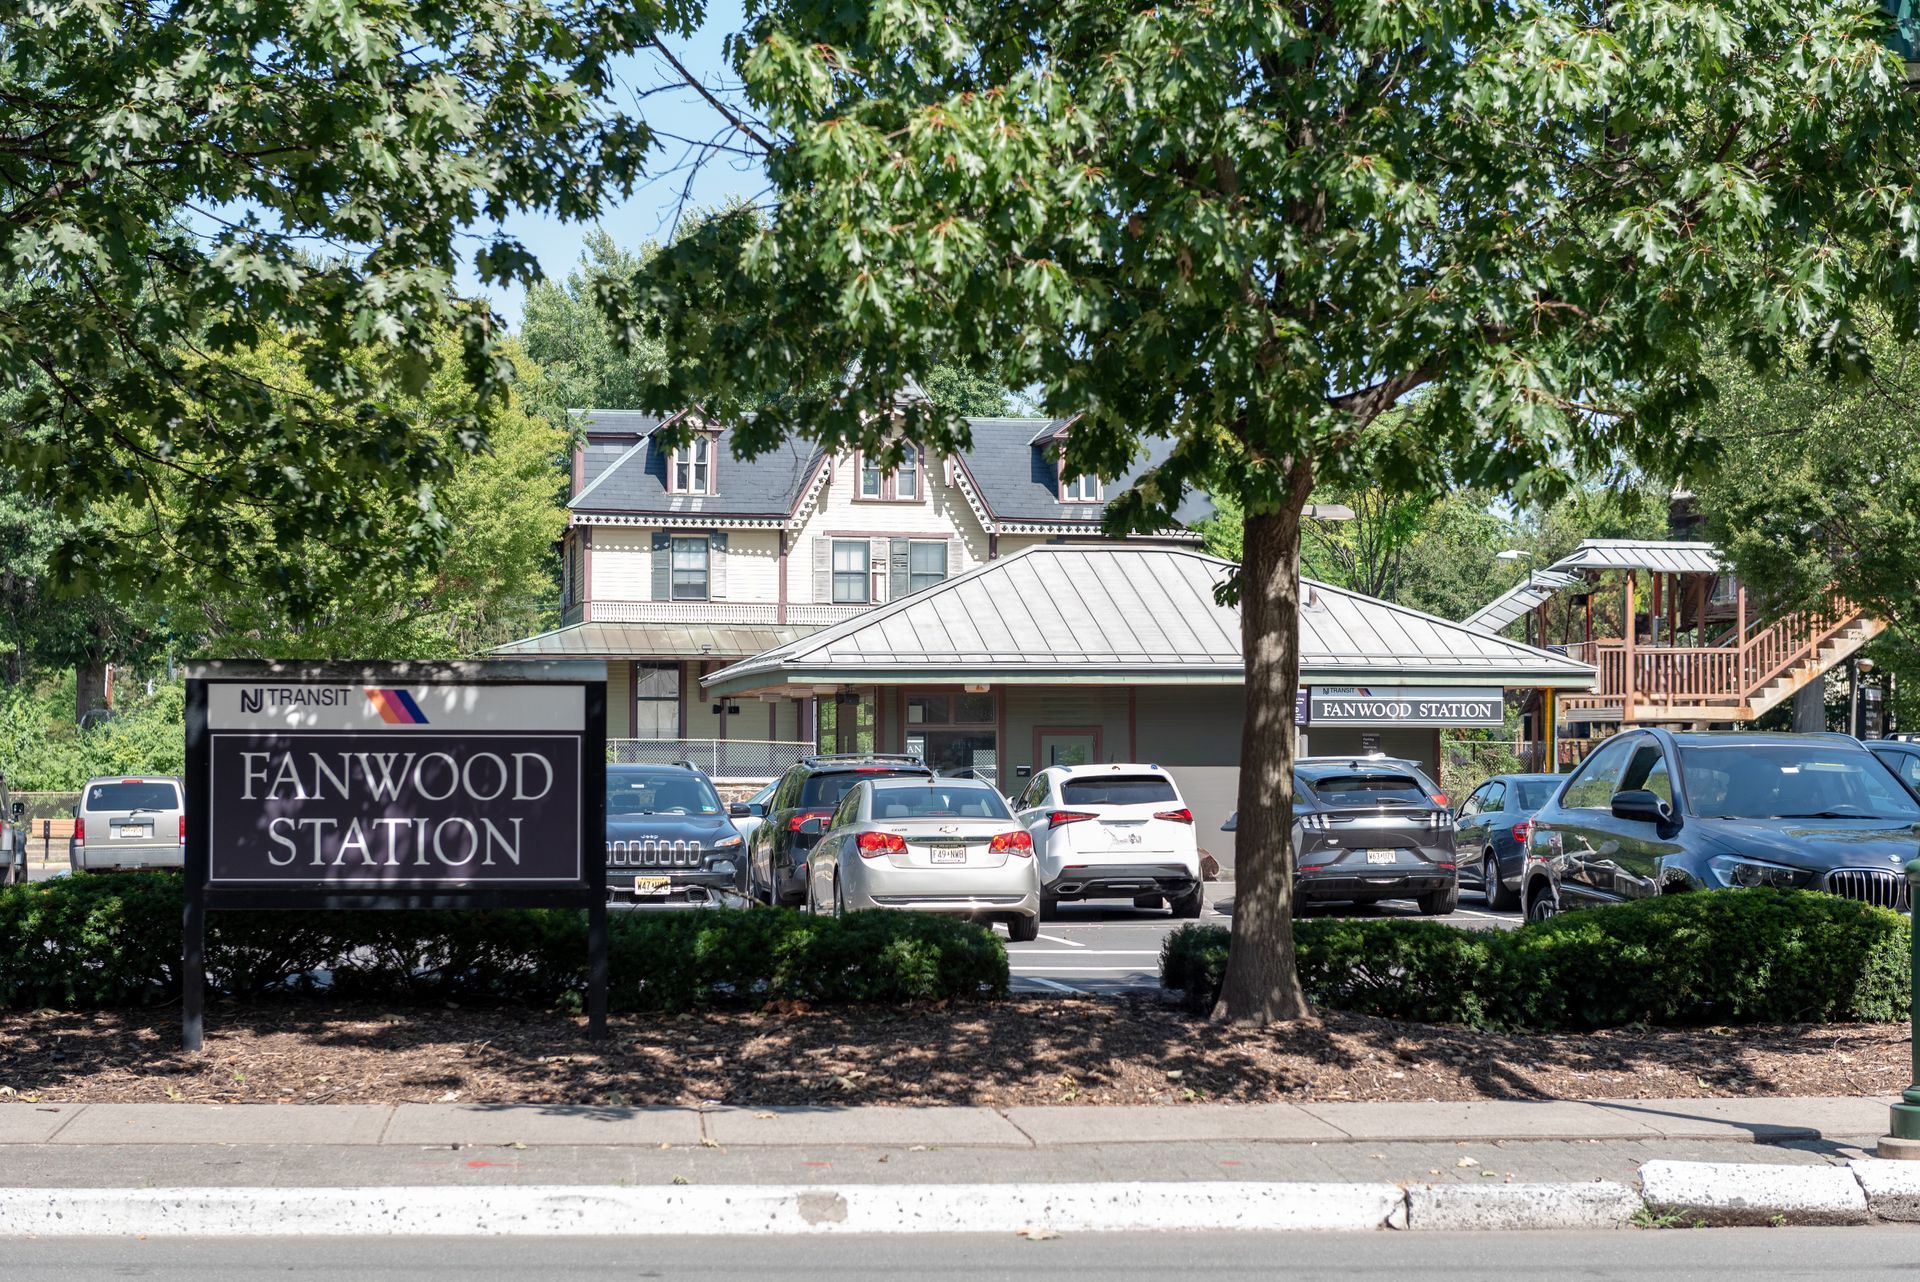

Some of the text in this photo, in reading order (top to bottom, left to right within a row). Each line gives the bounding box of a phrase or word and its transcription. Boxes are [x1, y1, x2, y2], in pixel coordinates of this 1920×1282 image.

[240, 688, 352, 713] NJ TRANSIT
[1322, 702, 1411, 717] FANWOOD
[1419, 703, 1492, 718] STATION
[239, 751, 554, 801] FANWOOD
[267, 817, 523, 866] STATION
